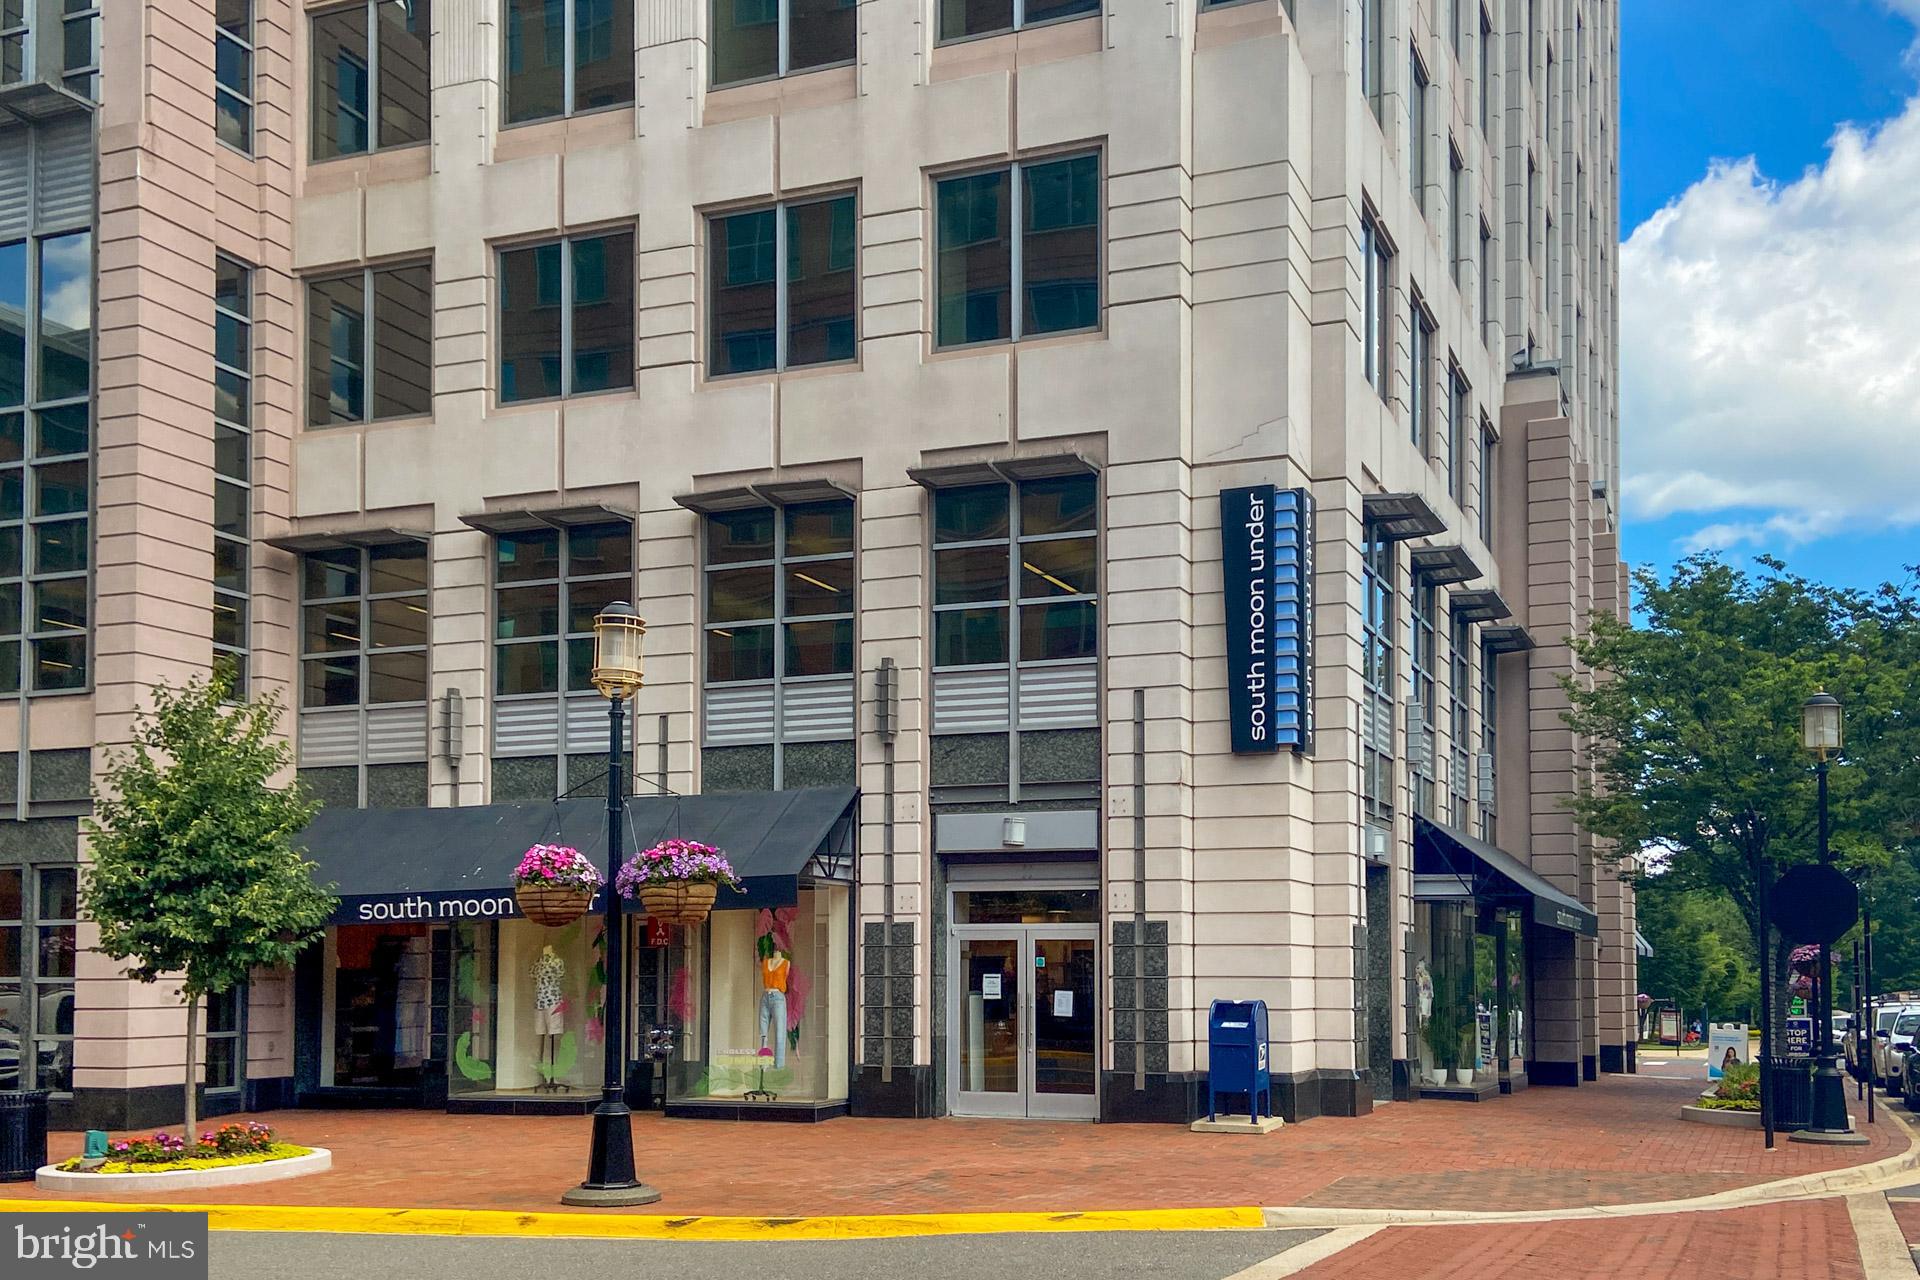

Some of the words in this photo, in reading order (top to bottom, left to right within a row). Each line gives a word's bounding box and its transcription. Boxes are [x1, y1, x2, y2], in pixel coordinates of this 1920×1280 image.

[1245, 493, 1265, 572] under
[1250, 579, 1265, 654] moon
[1246, 661, 1266, 741] south
[1306, 665, 1314, 743] under
[359, 896, 432, 920] south
[439, 897, 514, 917] moon
